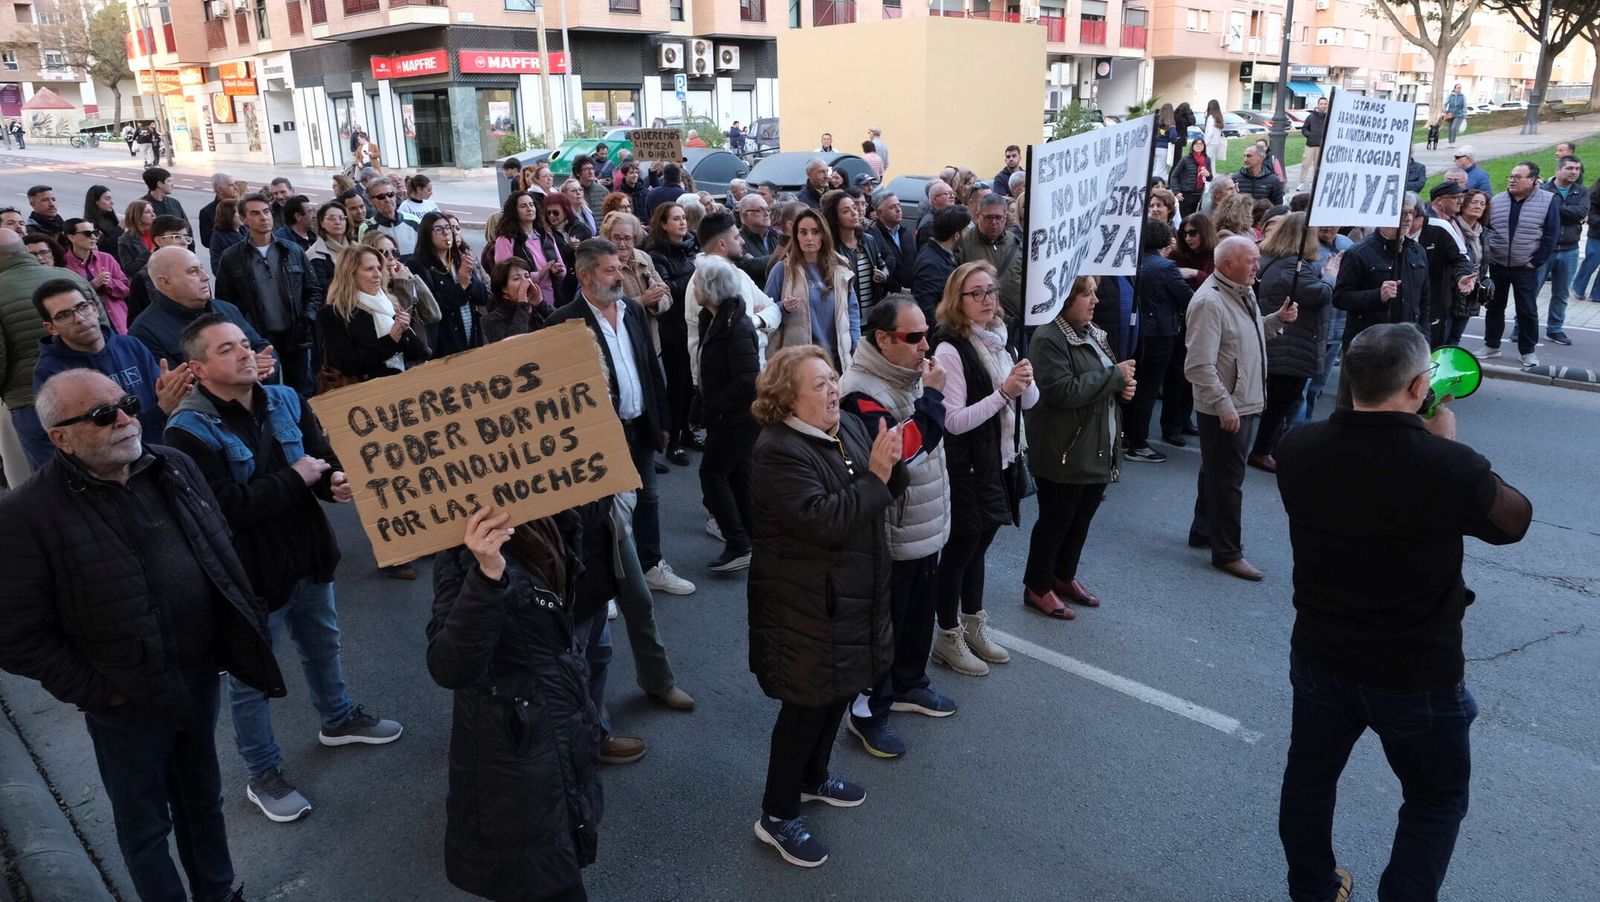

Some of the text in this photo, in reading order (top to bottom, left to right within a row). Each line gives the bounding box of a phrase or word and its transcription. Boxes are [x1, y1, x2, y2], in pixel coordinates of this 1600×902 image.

[402, 56, 437, 73] MAPFRE
[488, 56, 541, 69] MAPFR
[634, 131, 680, 140] QUEREMOS
[1390, 118, 1409, 132] POR
[634, 141, 674, 150] LIMPIEZA
[638, 150, 676, 159] A DIARIO
[1093, 136, 1111, 167] UN
[1355, 149, 1401, 168] ACOGIDA
[1051, 184, 1073, 220] NO
[1078, 174, 1097, 208] UN
[1318, 171, 1400, 216] FUERA YA
[1093, 224, 1137, 268] YA
[347, 362, 543, 438] QUEREMOS
[360, 422, 468, 475] PODER
[377, 452, 608, 542] POR LAS NOCHES
